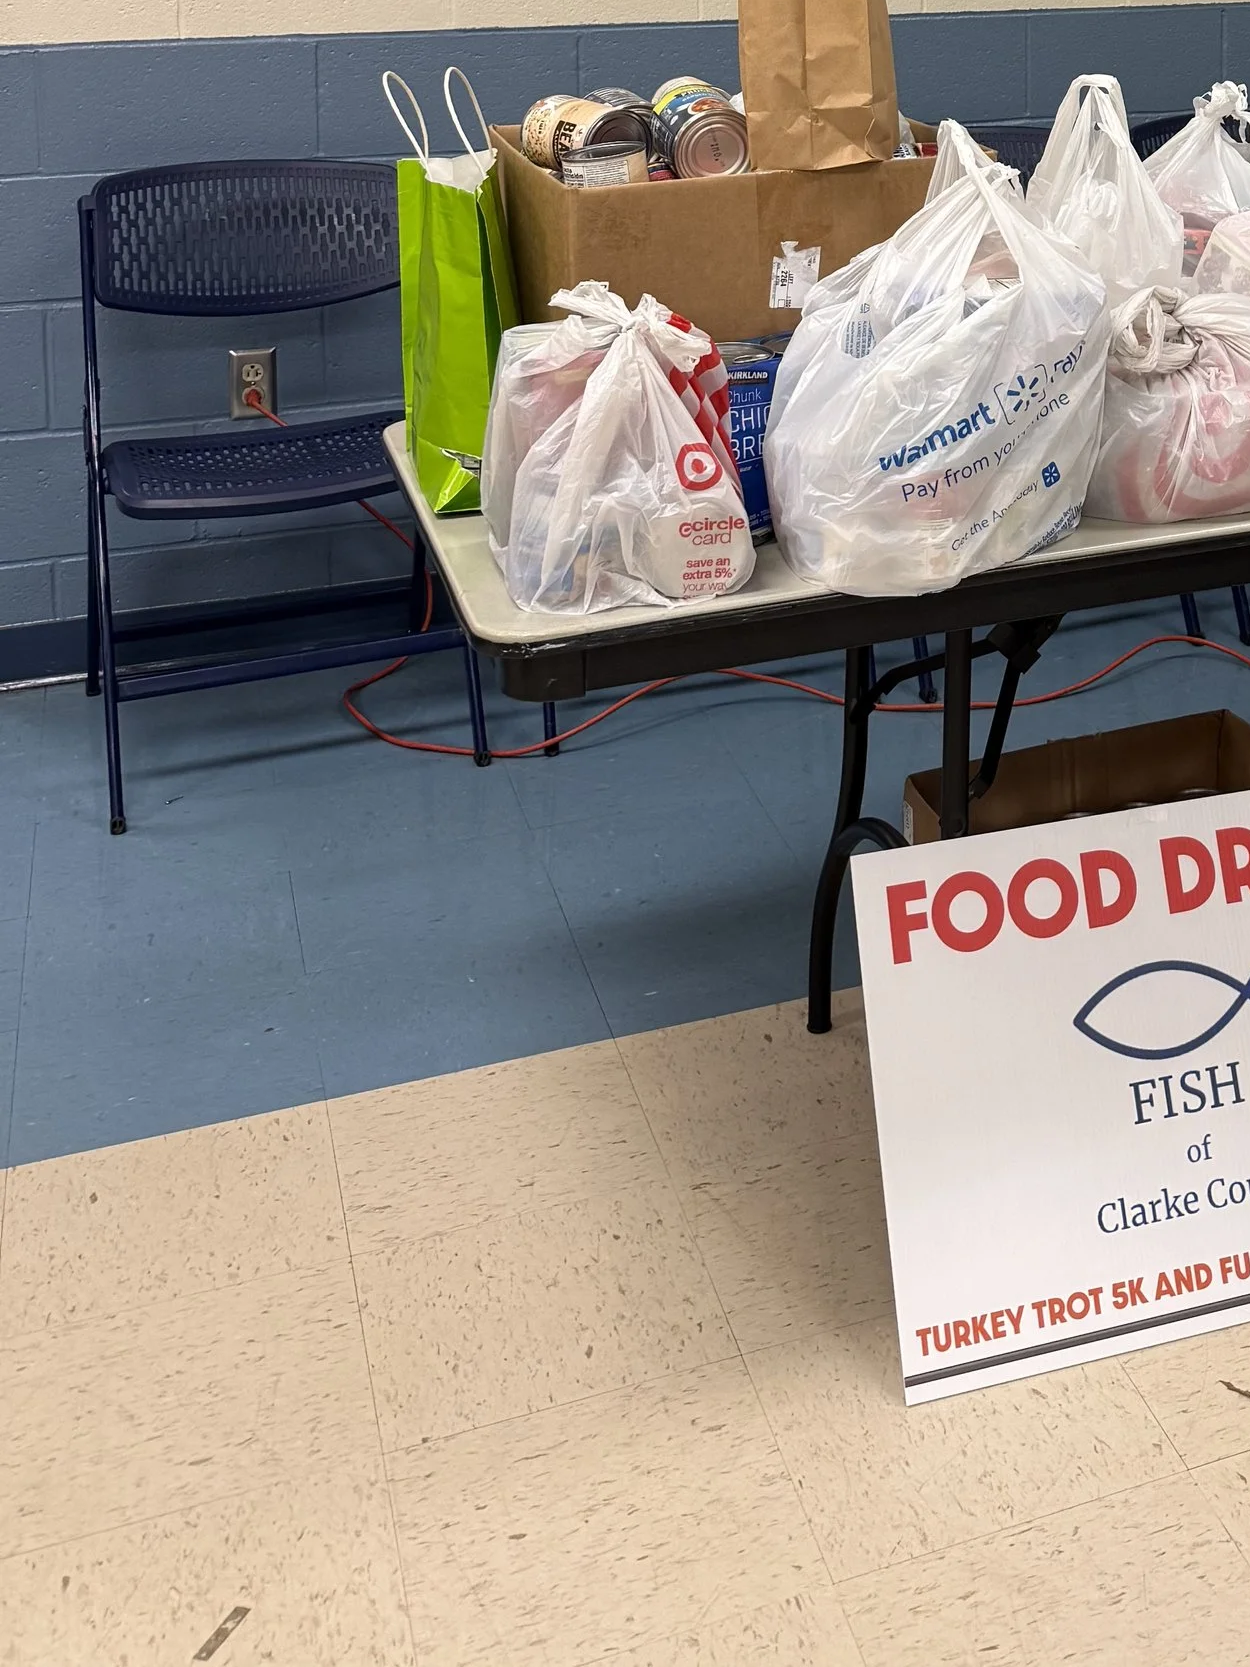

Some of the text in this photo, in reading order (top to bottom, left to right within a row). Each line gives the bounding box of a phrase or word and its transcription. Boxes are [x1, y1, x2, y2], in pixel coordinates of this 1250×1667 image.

[728, 371, 769, 381] KIRKLAND
[901, 477, 939, 503] Pay
[943, 454, 991, 489] from
[692, 531, 732, 546] card
[970, 519, 990, 536] the
[682, 568, 713, 581] extra
[686, 557, 731, 569] save an
[682, 581, 706, 594] your
[885, 849, 1137, 966] FOOD
[1128, 1061, 1246, 1126] FISH
[1186, 1134, 1213, 1164] of
[1097, 1189, 1201, 1235] Clarke
[915, 1309, 1025, 1358] TURKEY
[1029, 1287, 1105, 1332] TROT
[1111, 1277, 1146, 1309] 5K
[1154, 1263, 1213, 1302] AND
